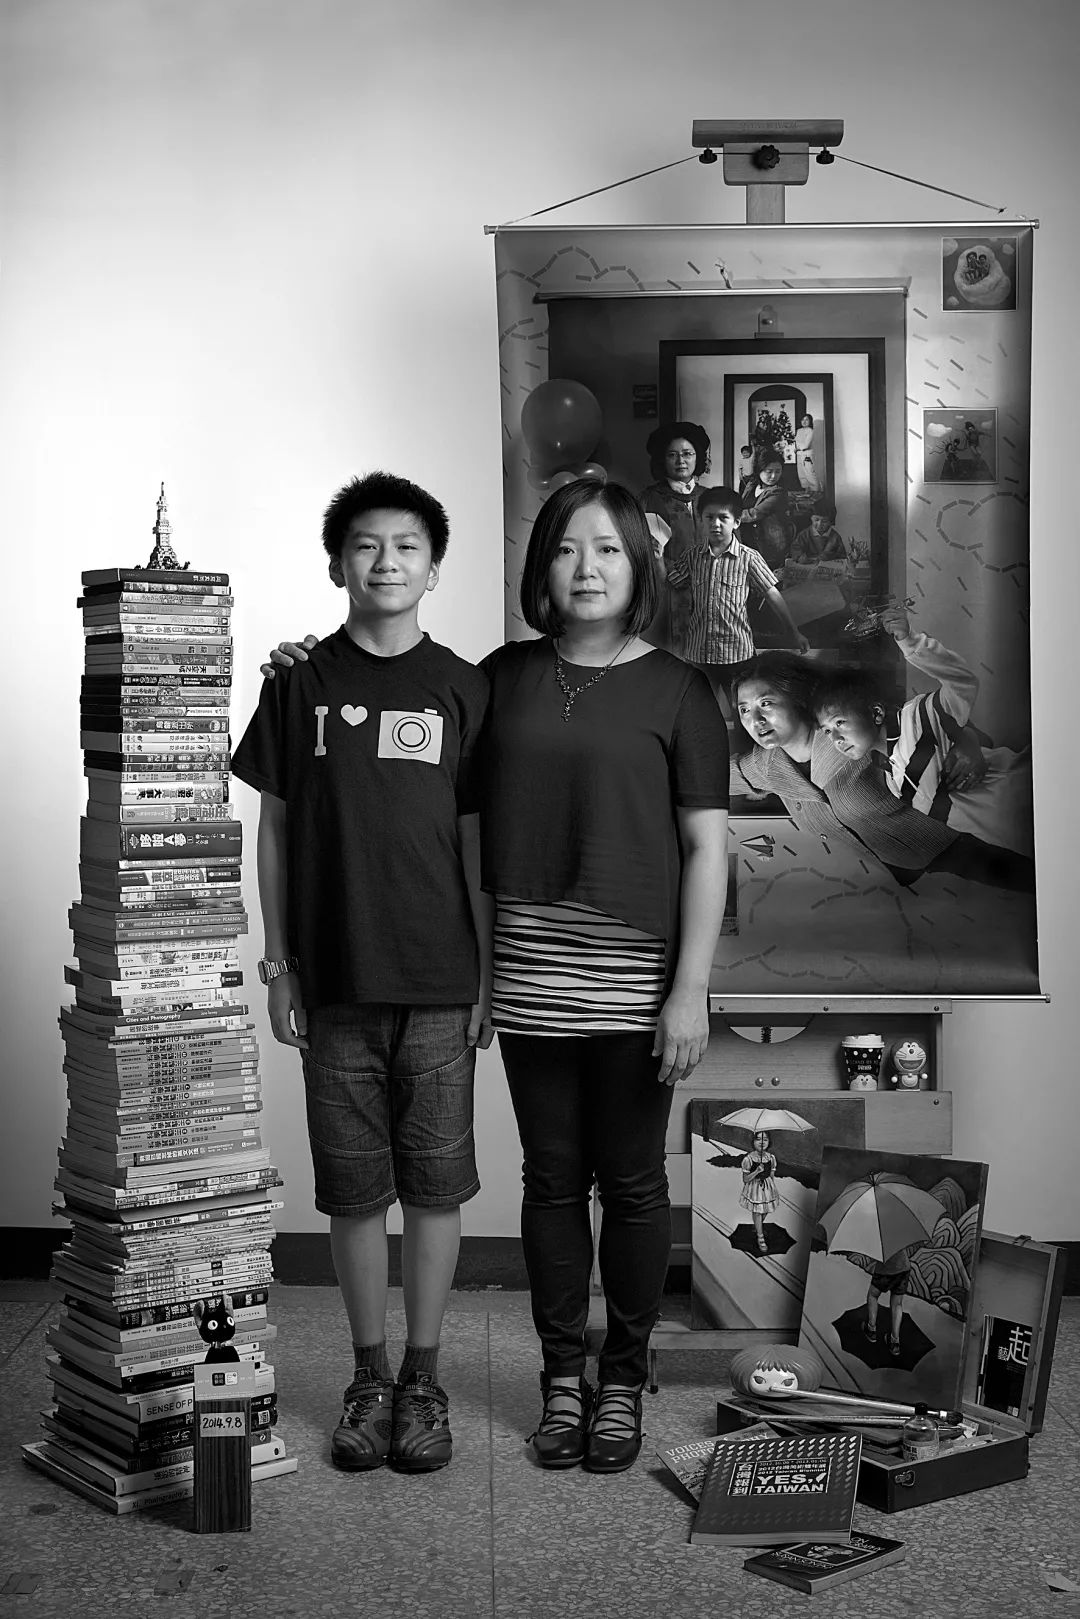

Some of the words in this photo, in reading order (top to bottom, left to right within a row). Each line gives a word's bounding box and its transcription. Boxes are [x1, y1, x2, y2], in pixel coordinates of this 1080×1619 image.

[315, 706, 328, 757] I
[150, 1013, 181, 1022] Photography
[146, 1403, 174, 1416] SENSE
[175, 1401, 186, 1410] OF
[202, 1416, 243, 1429] 2014.9.8
[666, 1440, 715, 1457] VOICES
[754, 1484, 824, 1494] TAIWAN
